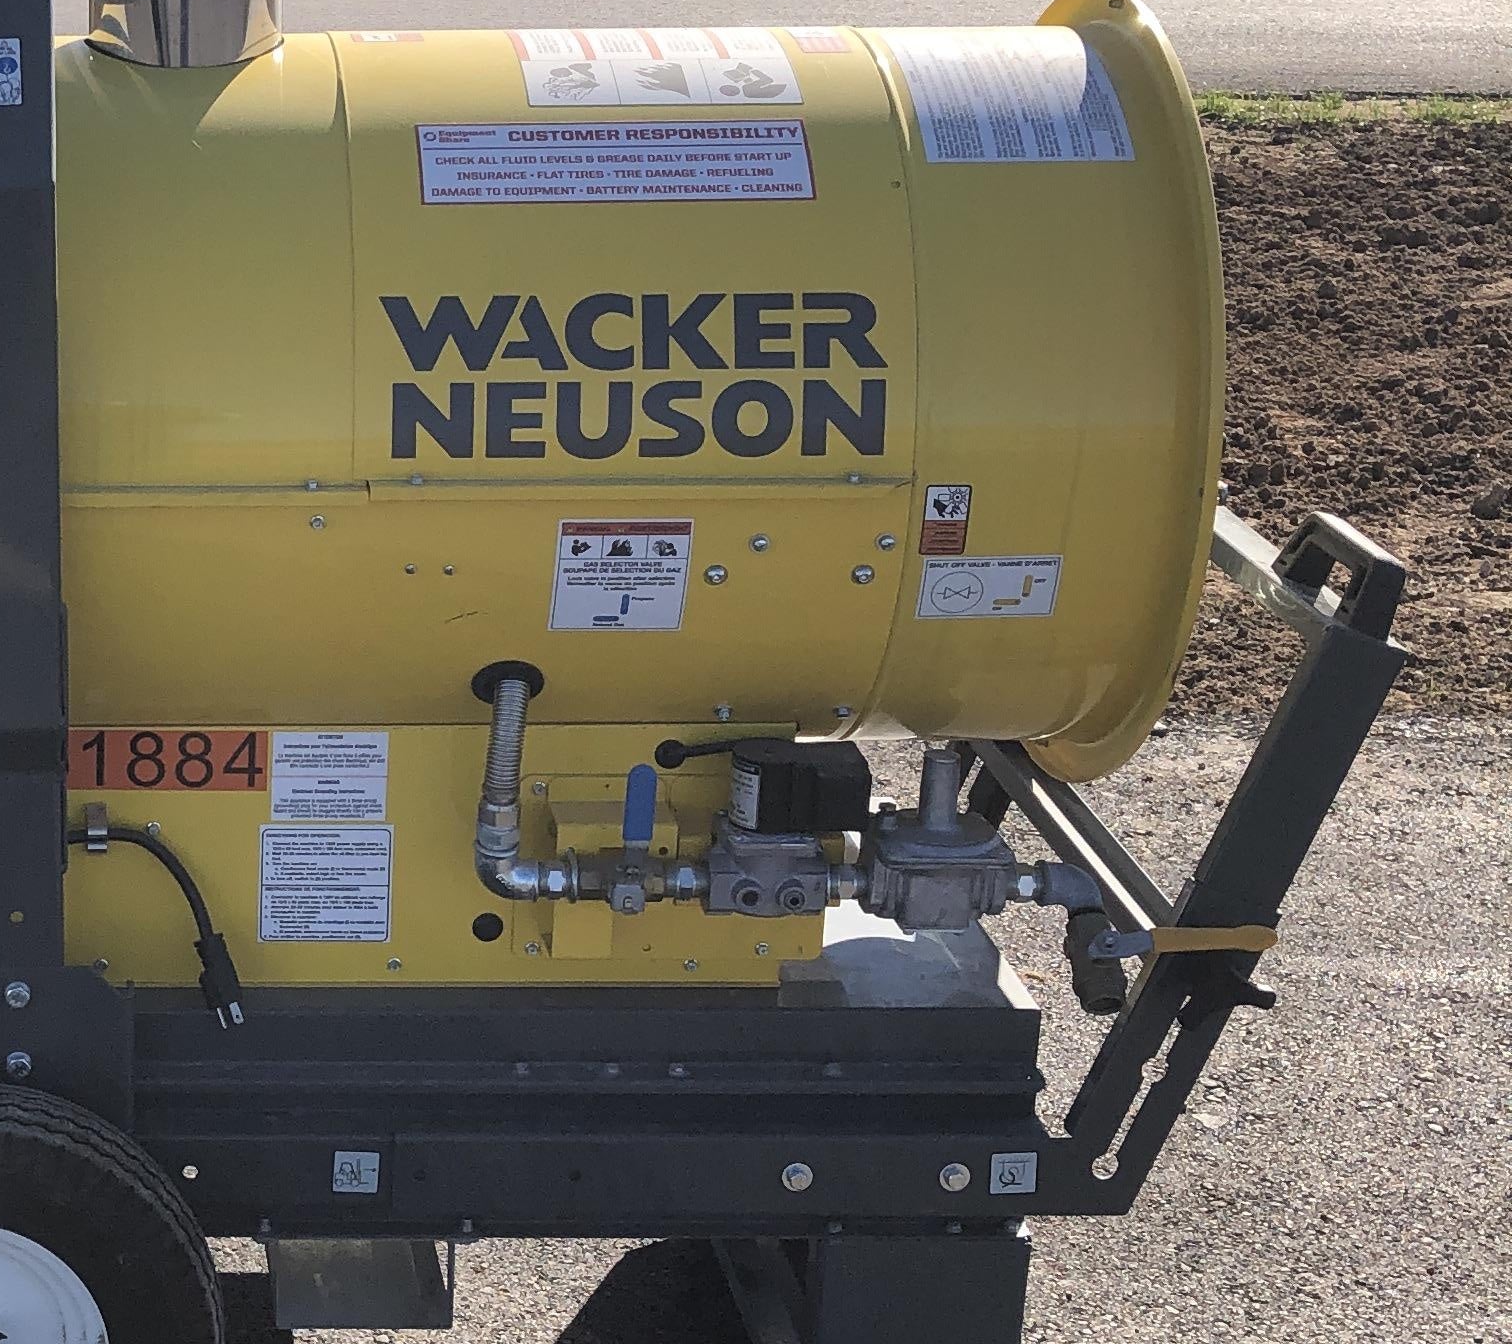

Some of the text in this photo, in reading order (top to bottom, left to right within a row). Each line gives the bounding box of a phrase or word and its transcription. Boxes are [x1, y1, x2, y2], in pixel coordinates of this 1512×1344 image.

[508, 127, 799, 142] CUSTOMER RESPONSIBILITY
[435, 156, 475, 165] CHECK
[478, 156, 499, 165] ALL
[501, 156, 537, 164] FLUID
[540, 155, 583, 164] LEVELS
[597, 154, 644, 163] GREASE
[647, 154, 681, 163] DAILY
[685, 153, 731, 162] BEFORE
[734, 153, 773, 162] START
[775, 152, 792, 161] UP
[456, 167, 774, 180] INSURANCE FLAT TIRES TIRE DAMAGE REFUELING
[431, 183, 804, 197] DAMAGE TO EQUIPMENT BATTERY MAINTENANCE CLEANING
[378, 291, 890, 371] WACKER
[391, 378, 888, 460] NEUSON
[81, 731, 264, 788] 1884
